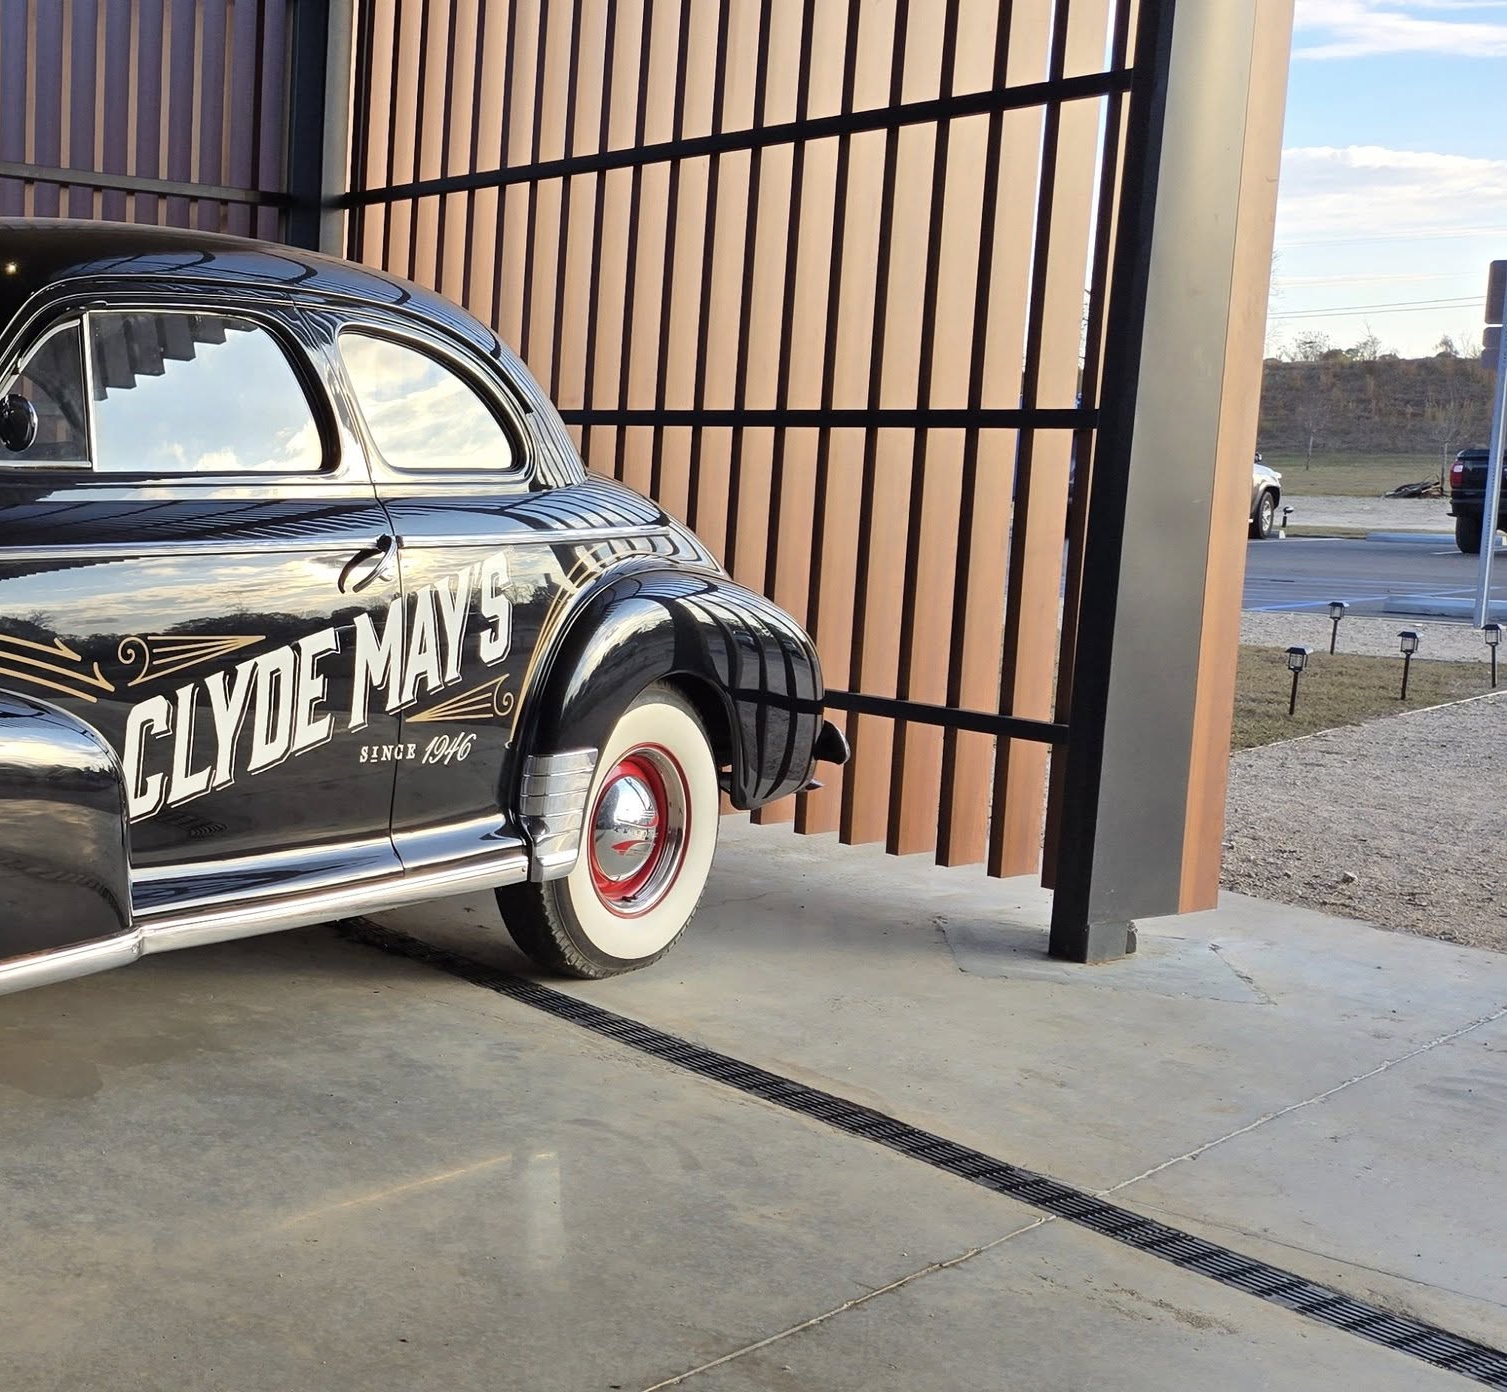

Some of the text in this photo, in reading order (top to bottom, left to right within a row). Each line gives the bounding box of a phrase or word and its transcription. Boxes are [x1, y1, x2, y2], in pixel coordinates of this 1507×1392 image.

[122, 551, 513, 825] CLYDE MAY'S
[359, 731, 477, 765] SINCE 1946
